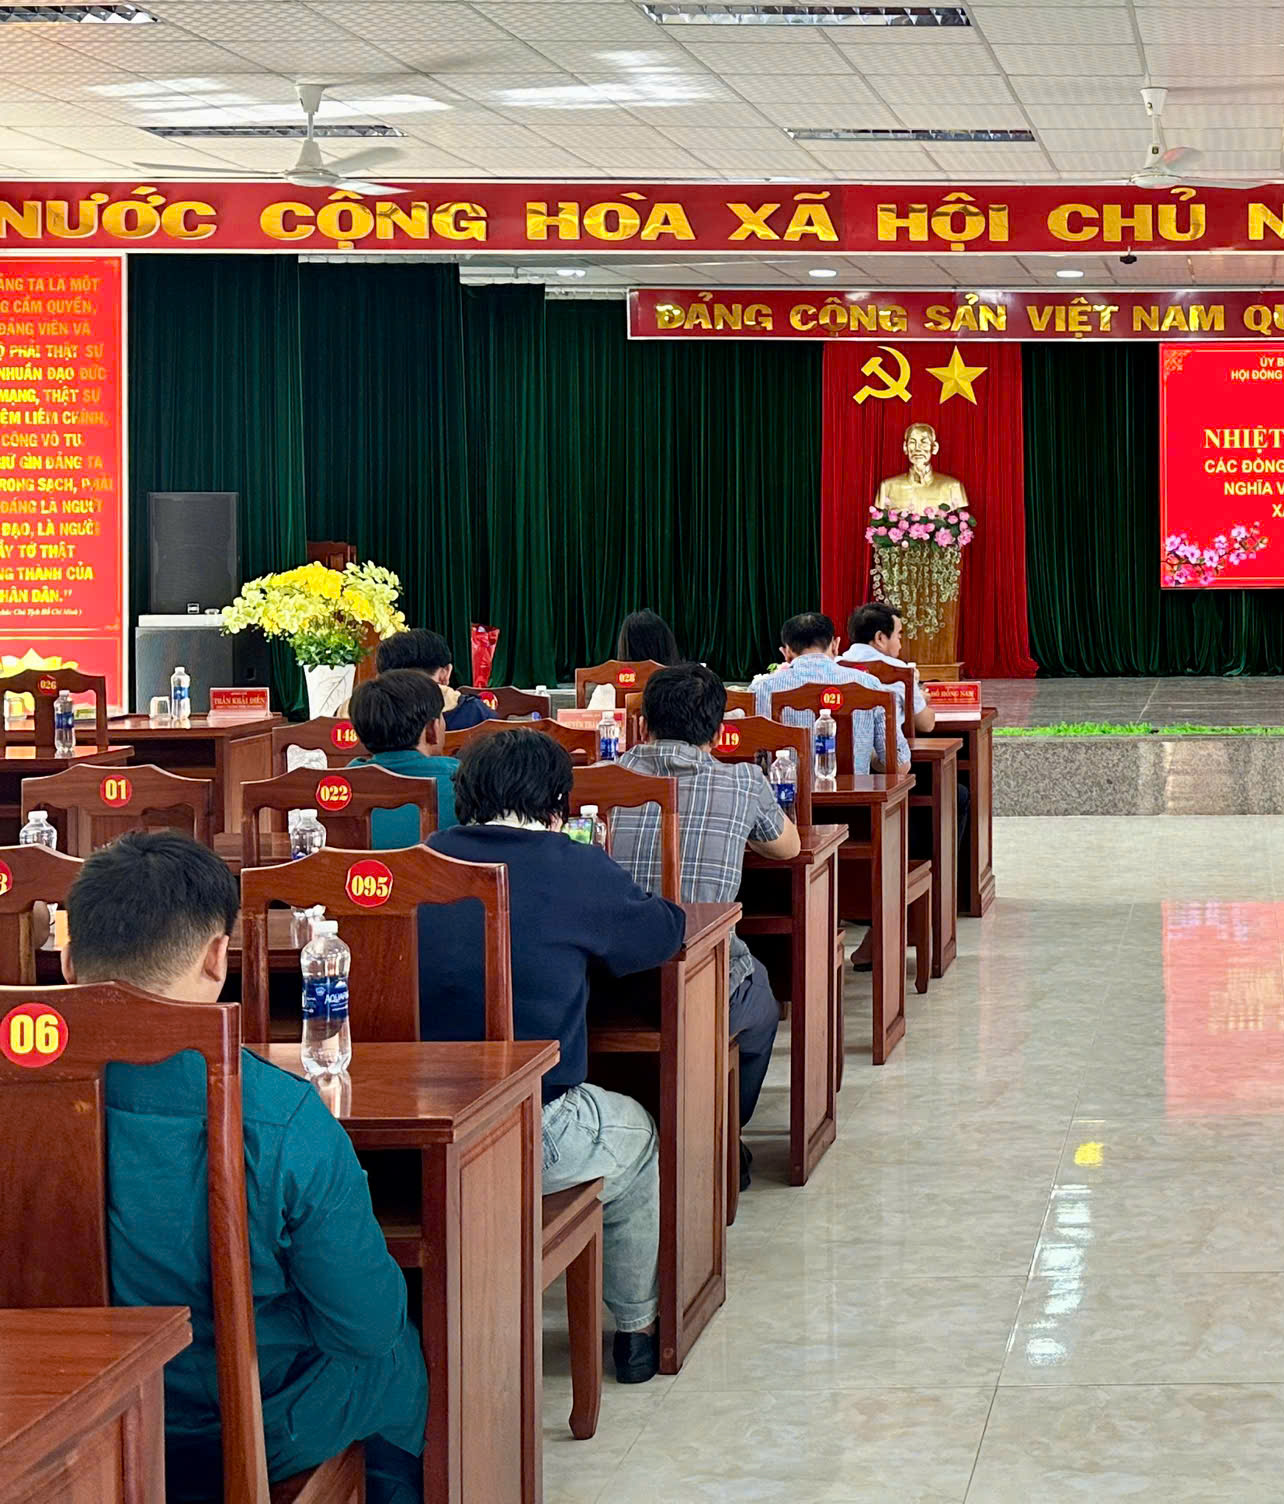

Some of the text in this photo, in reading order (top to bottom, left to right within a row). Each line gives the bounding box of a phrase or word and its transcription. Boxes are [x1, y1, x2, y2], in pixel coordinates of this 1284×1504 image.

[0, 185, 217, 241] NƯỚC
[259, 190, 489, 249] CỘNG
[727, 191, 840, 242] XÃ
[877, 192, 1009, 252] HỘI
[1047, 187, 1207, 242] CHỦ
[27, 278, 45, 292] TA
[656, 292, 774, 331] ĐẢNG
[789, 296, 908, 336] CỘNG
[924, 293, 1008, 331] SẢN
[1026, 297, 1120, 337] VIỆT
[1132, 304, 1226, 332] NAM
[47, 367, 75, 384] ĐẠO
[1231, 369, 1250, 382] HỘI
[1204, 457, 1239, 474] CÁC
[1224, 478, 1273, 496] NGHĨA
[66, 561, 94, 581] CỦA
[823, 693, 840, 704] 021
[336, 729, 358, 742] 148
[106, 779, 127, 800] 01
[320, 785, 348, 801] 022
[351, 875, 389, 896] 095
[9, 1013, 59, 1054] 06
